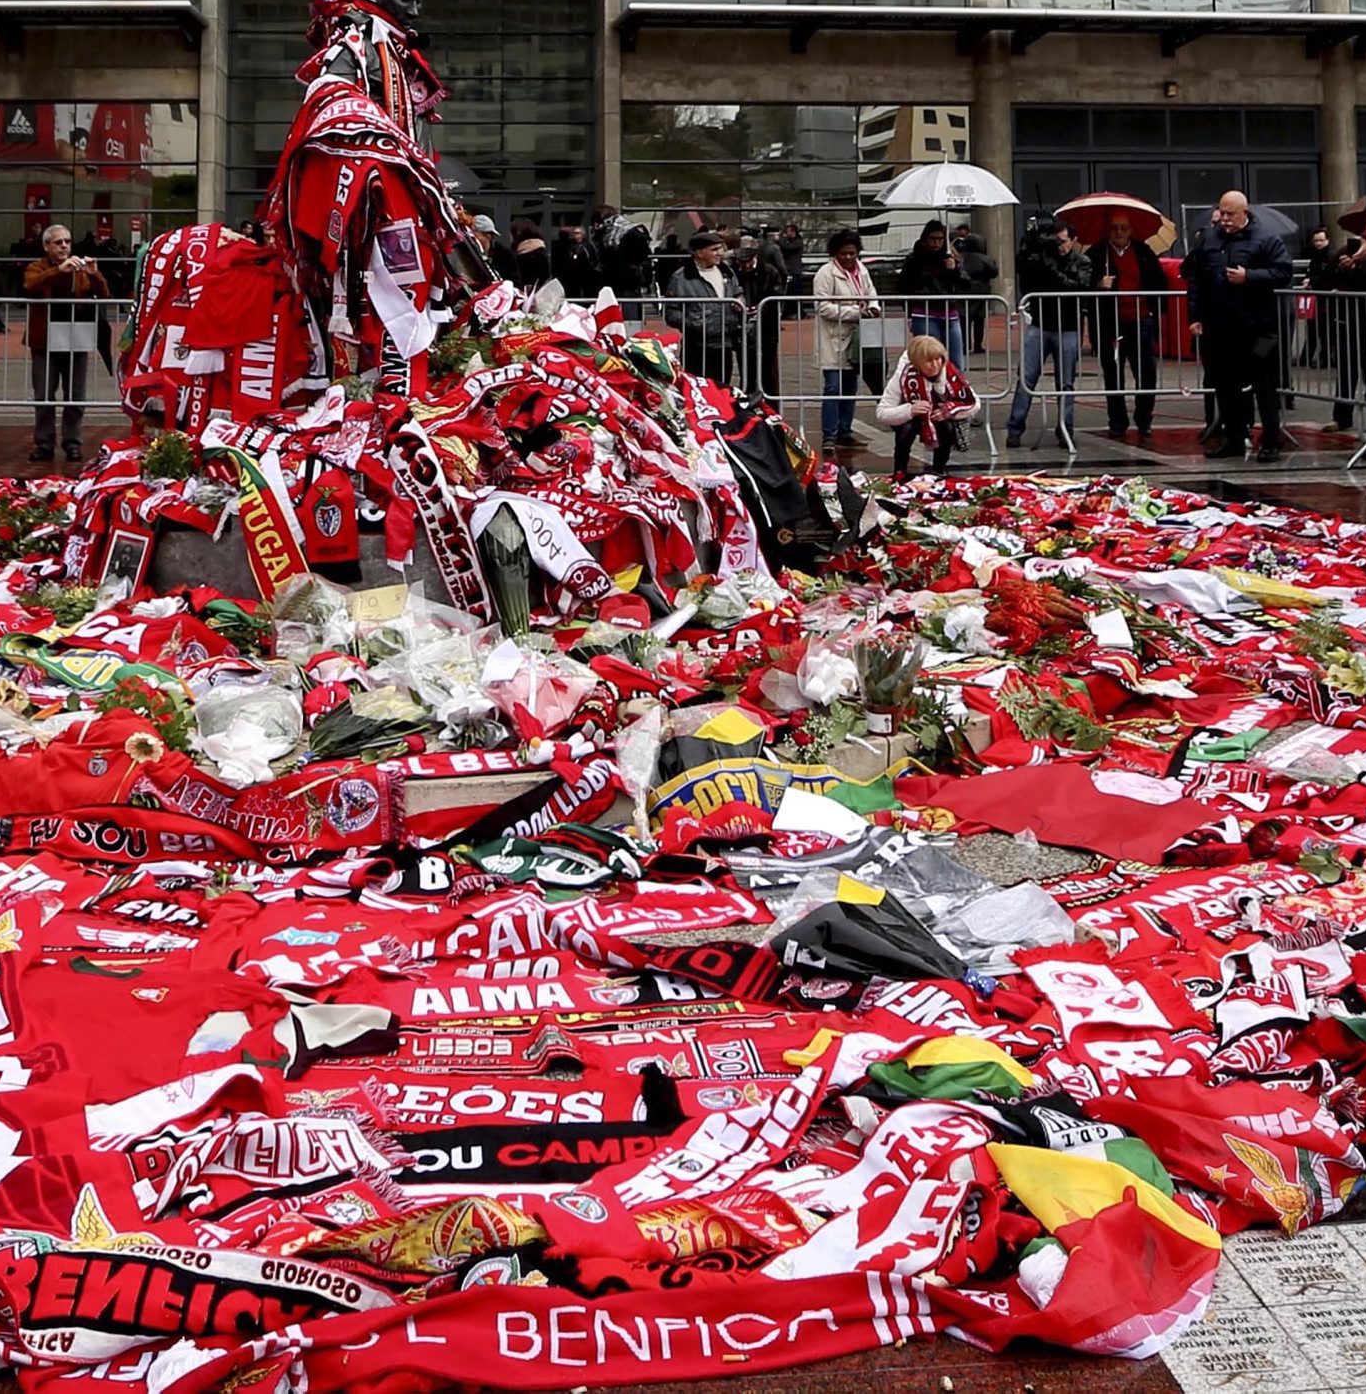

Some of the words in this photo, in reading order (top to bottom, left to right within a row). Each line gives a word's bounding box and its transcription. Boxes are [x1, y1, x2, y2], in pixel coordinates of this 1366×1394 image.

[557, 757, 615, 818] LISBO
[29, 817, 63, 847] EU
[70, 818, 150, 859] SOU
[411, 982, 575, 1017] ALMA
[412, 1038, 513, 1057] LISBOA
